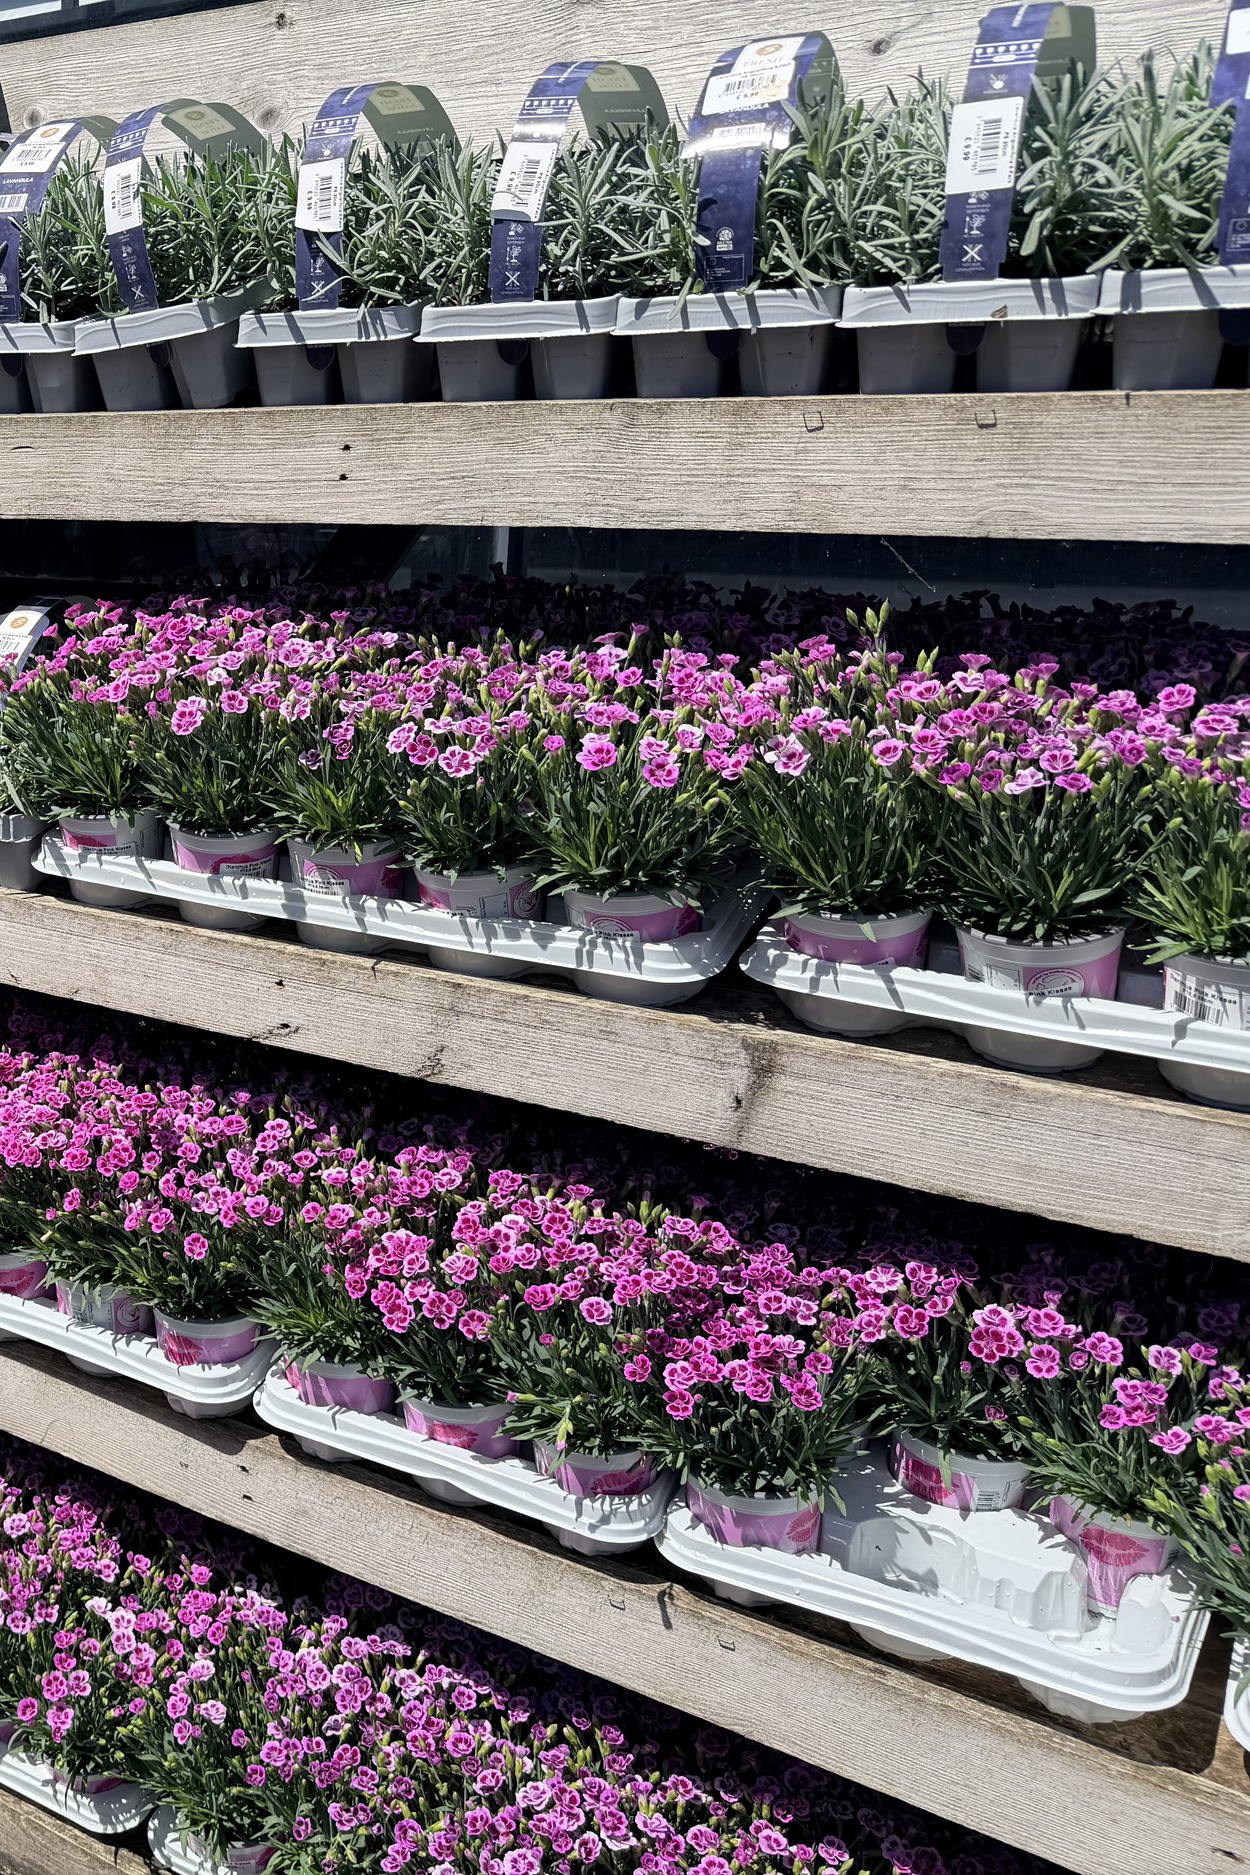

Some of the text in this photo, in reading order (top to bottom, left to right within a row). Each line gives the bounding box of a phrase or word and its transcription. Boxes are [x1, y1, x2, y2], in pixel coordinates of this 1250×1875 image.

[962, 144, 971, 161] 9.99
[1048, 986, 1072, 996] Kisses
[1194, 986, 1209, 997] Pink
[1211, 993, 1237, 1004] Kisses
